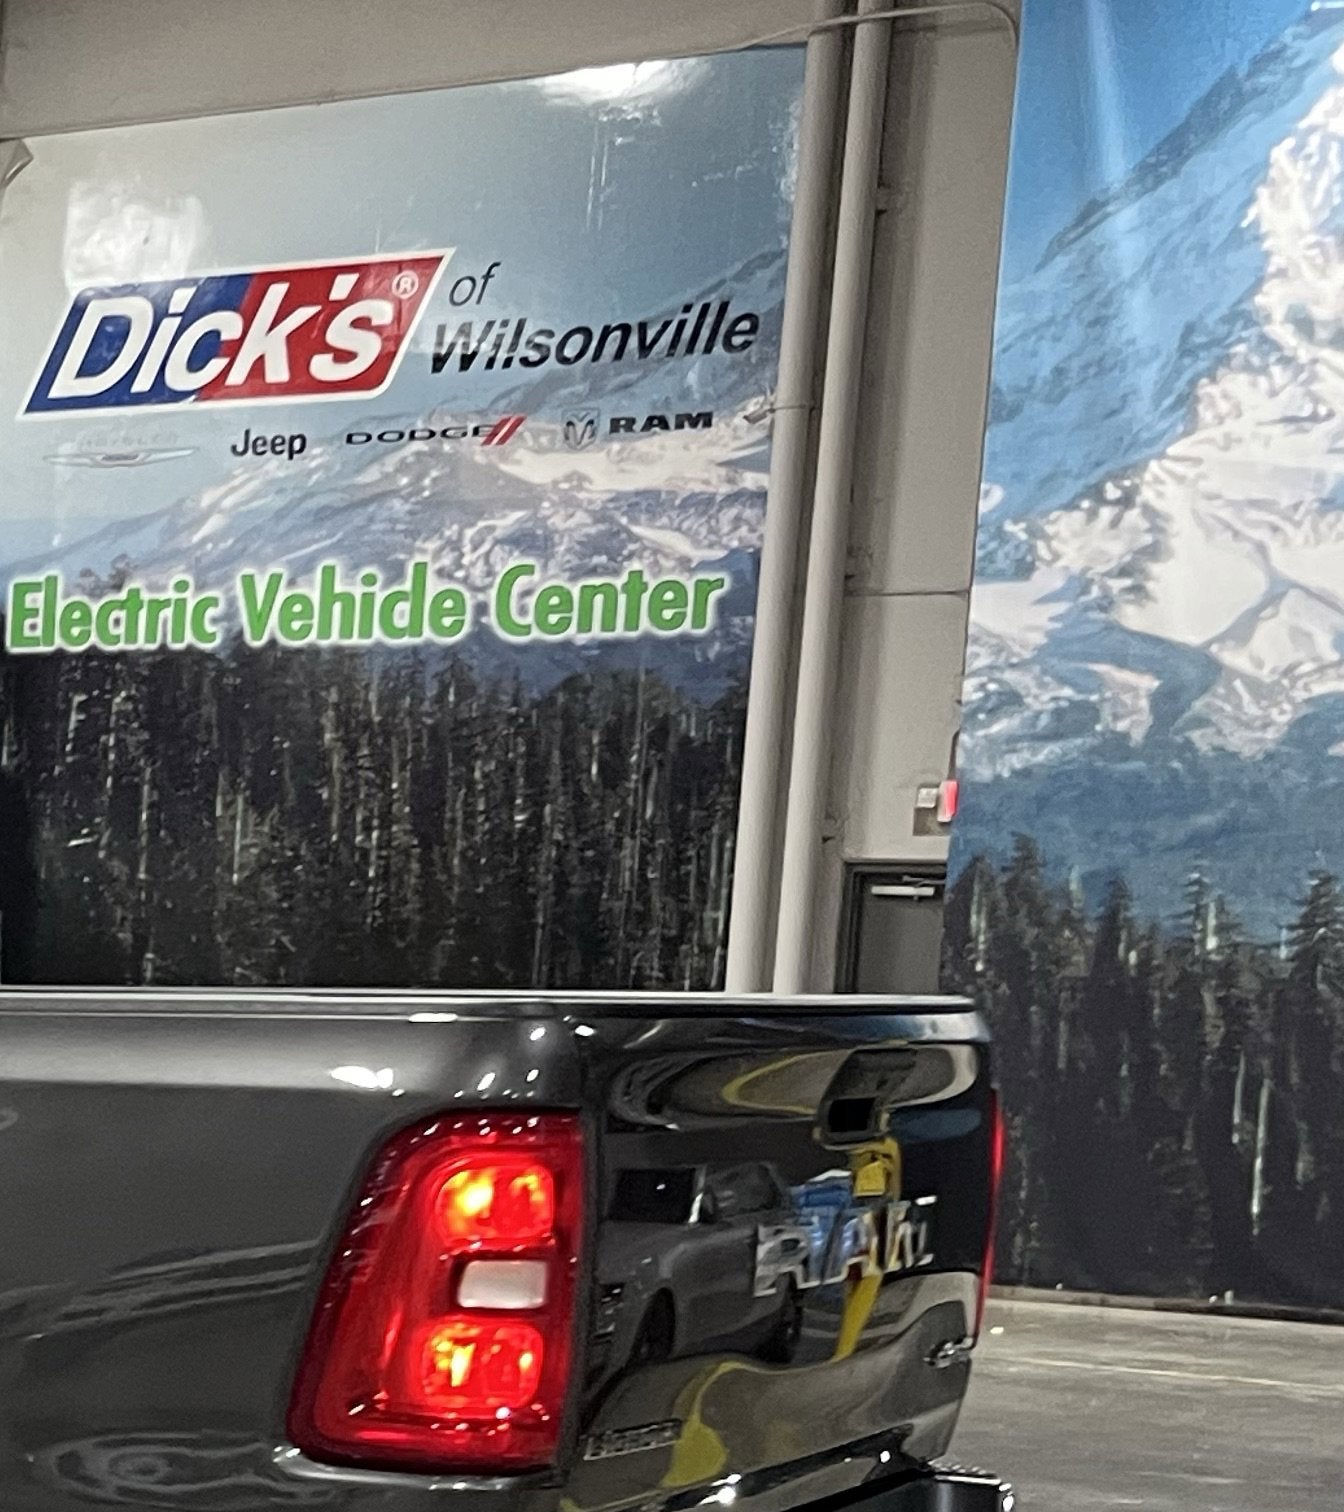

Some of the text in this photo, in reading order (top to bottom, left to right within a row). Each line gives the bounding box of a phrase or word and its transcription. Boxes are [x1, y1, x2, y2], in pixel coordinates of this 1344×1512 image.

[48, 262, 501, 399] Dick's of
[431, 300, 760, 374] Wilsonville
[231, 411, 714, 461] Jeep DODGE RAM
[11, 561, 725, 649] Electric Vehicle Center
